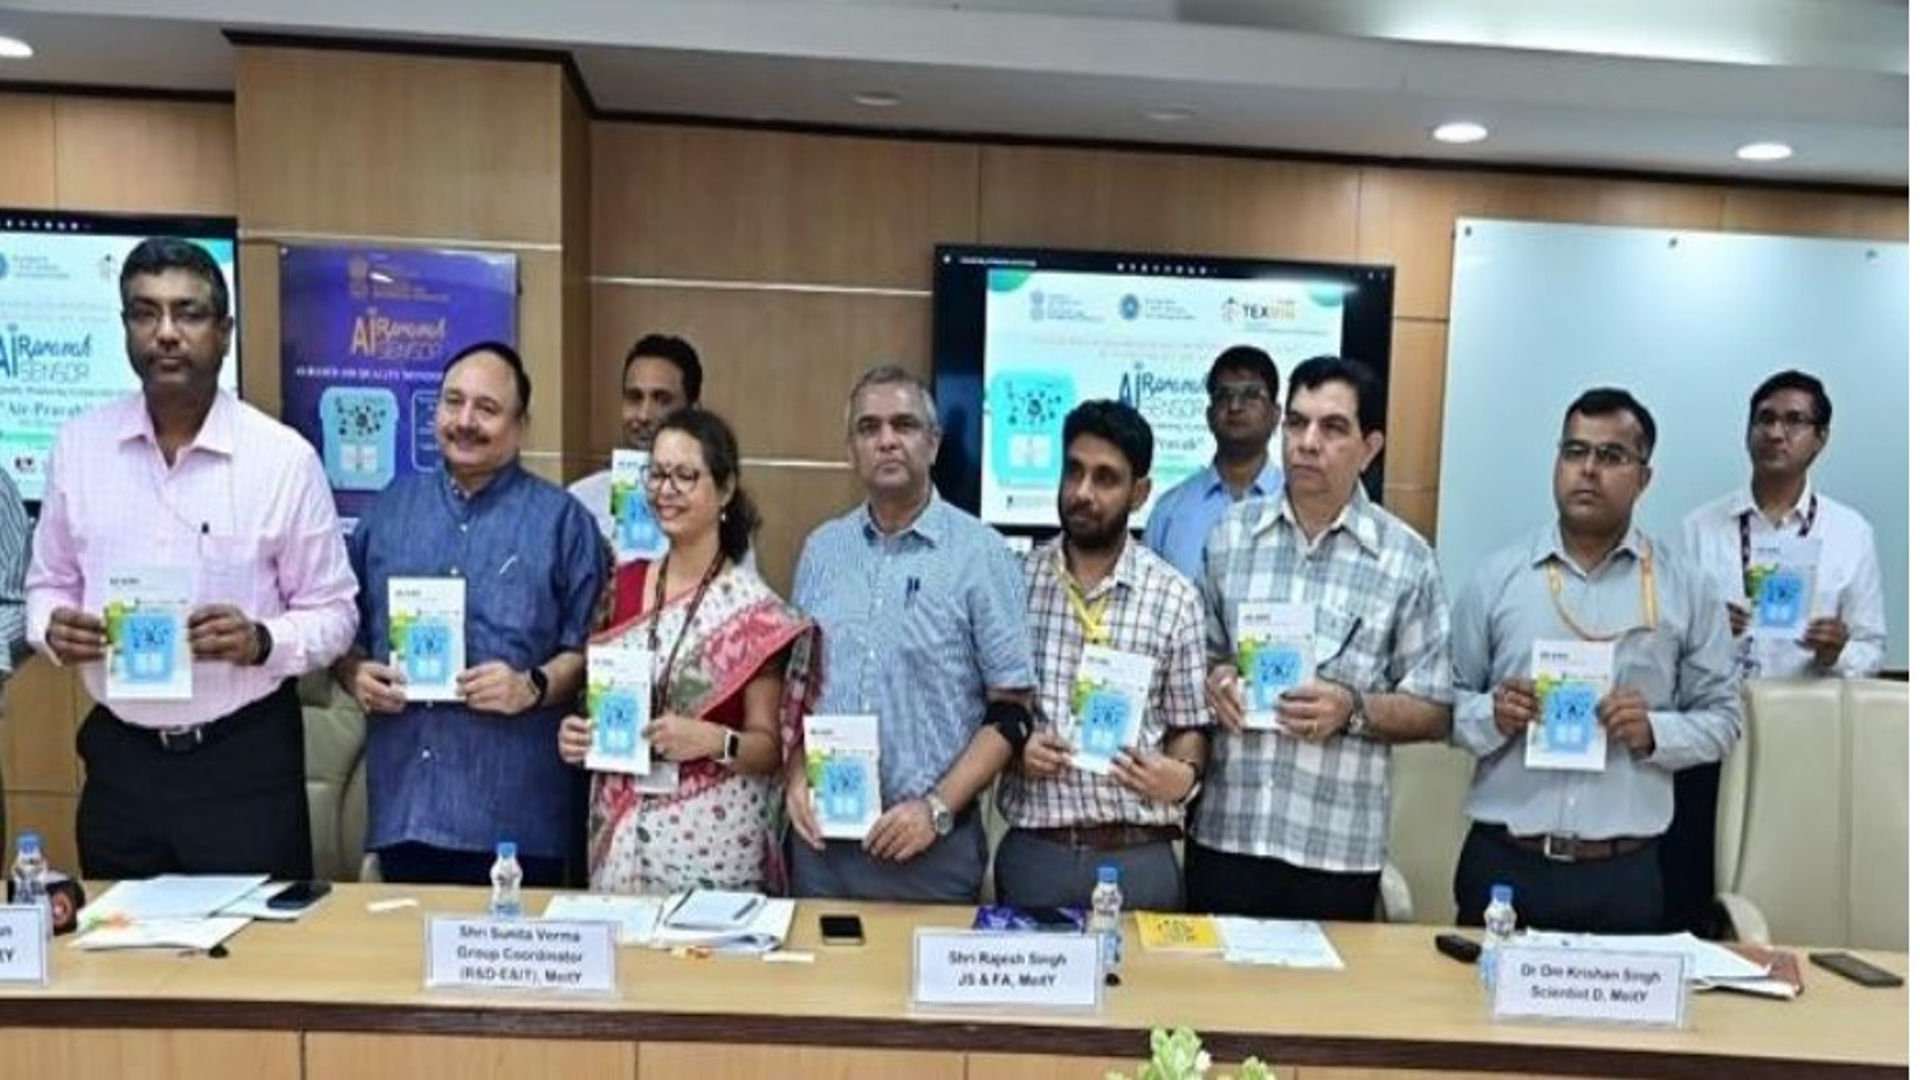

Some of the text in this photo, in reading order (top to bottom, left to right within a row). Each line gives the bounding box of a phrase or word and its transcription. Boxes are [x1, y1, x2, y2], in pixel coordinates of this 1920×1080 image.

[459, 925, 580, 942] Shri Sunita Verma
[457, 946, 583, 963] Group Coordinator
[949, 950, 1068, 969] Shri Rajesh Singh
[958, 973, 975, 987] JS
[979, 973, 990, 987] &
[1520, 963, 1536, 977] Dr
[1566, 965, 1620, 982] Krishan
[1623, 968, 1662, 986] Singh
[1531, 985, 1589, 1001] Scientist
